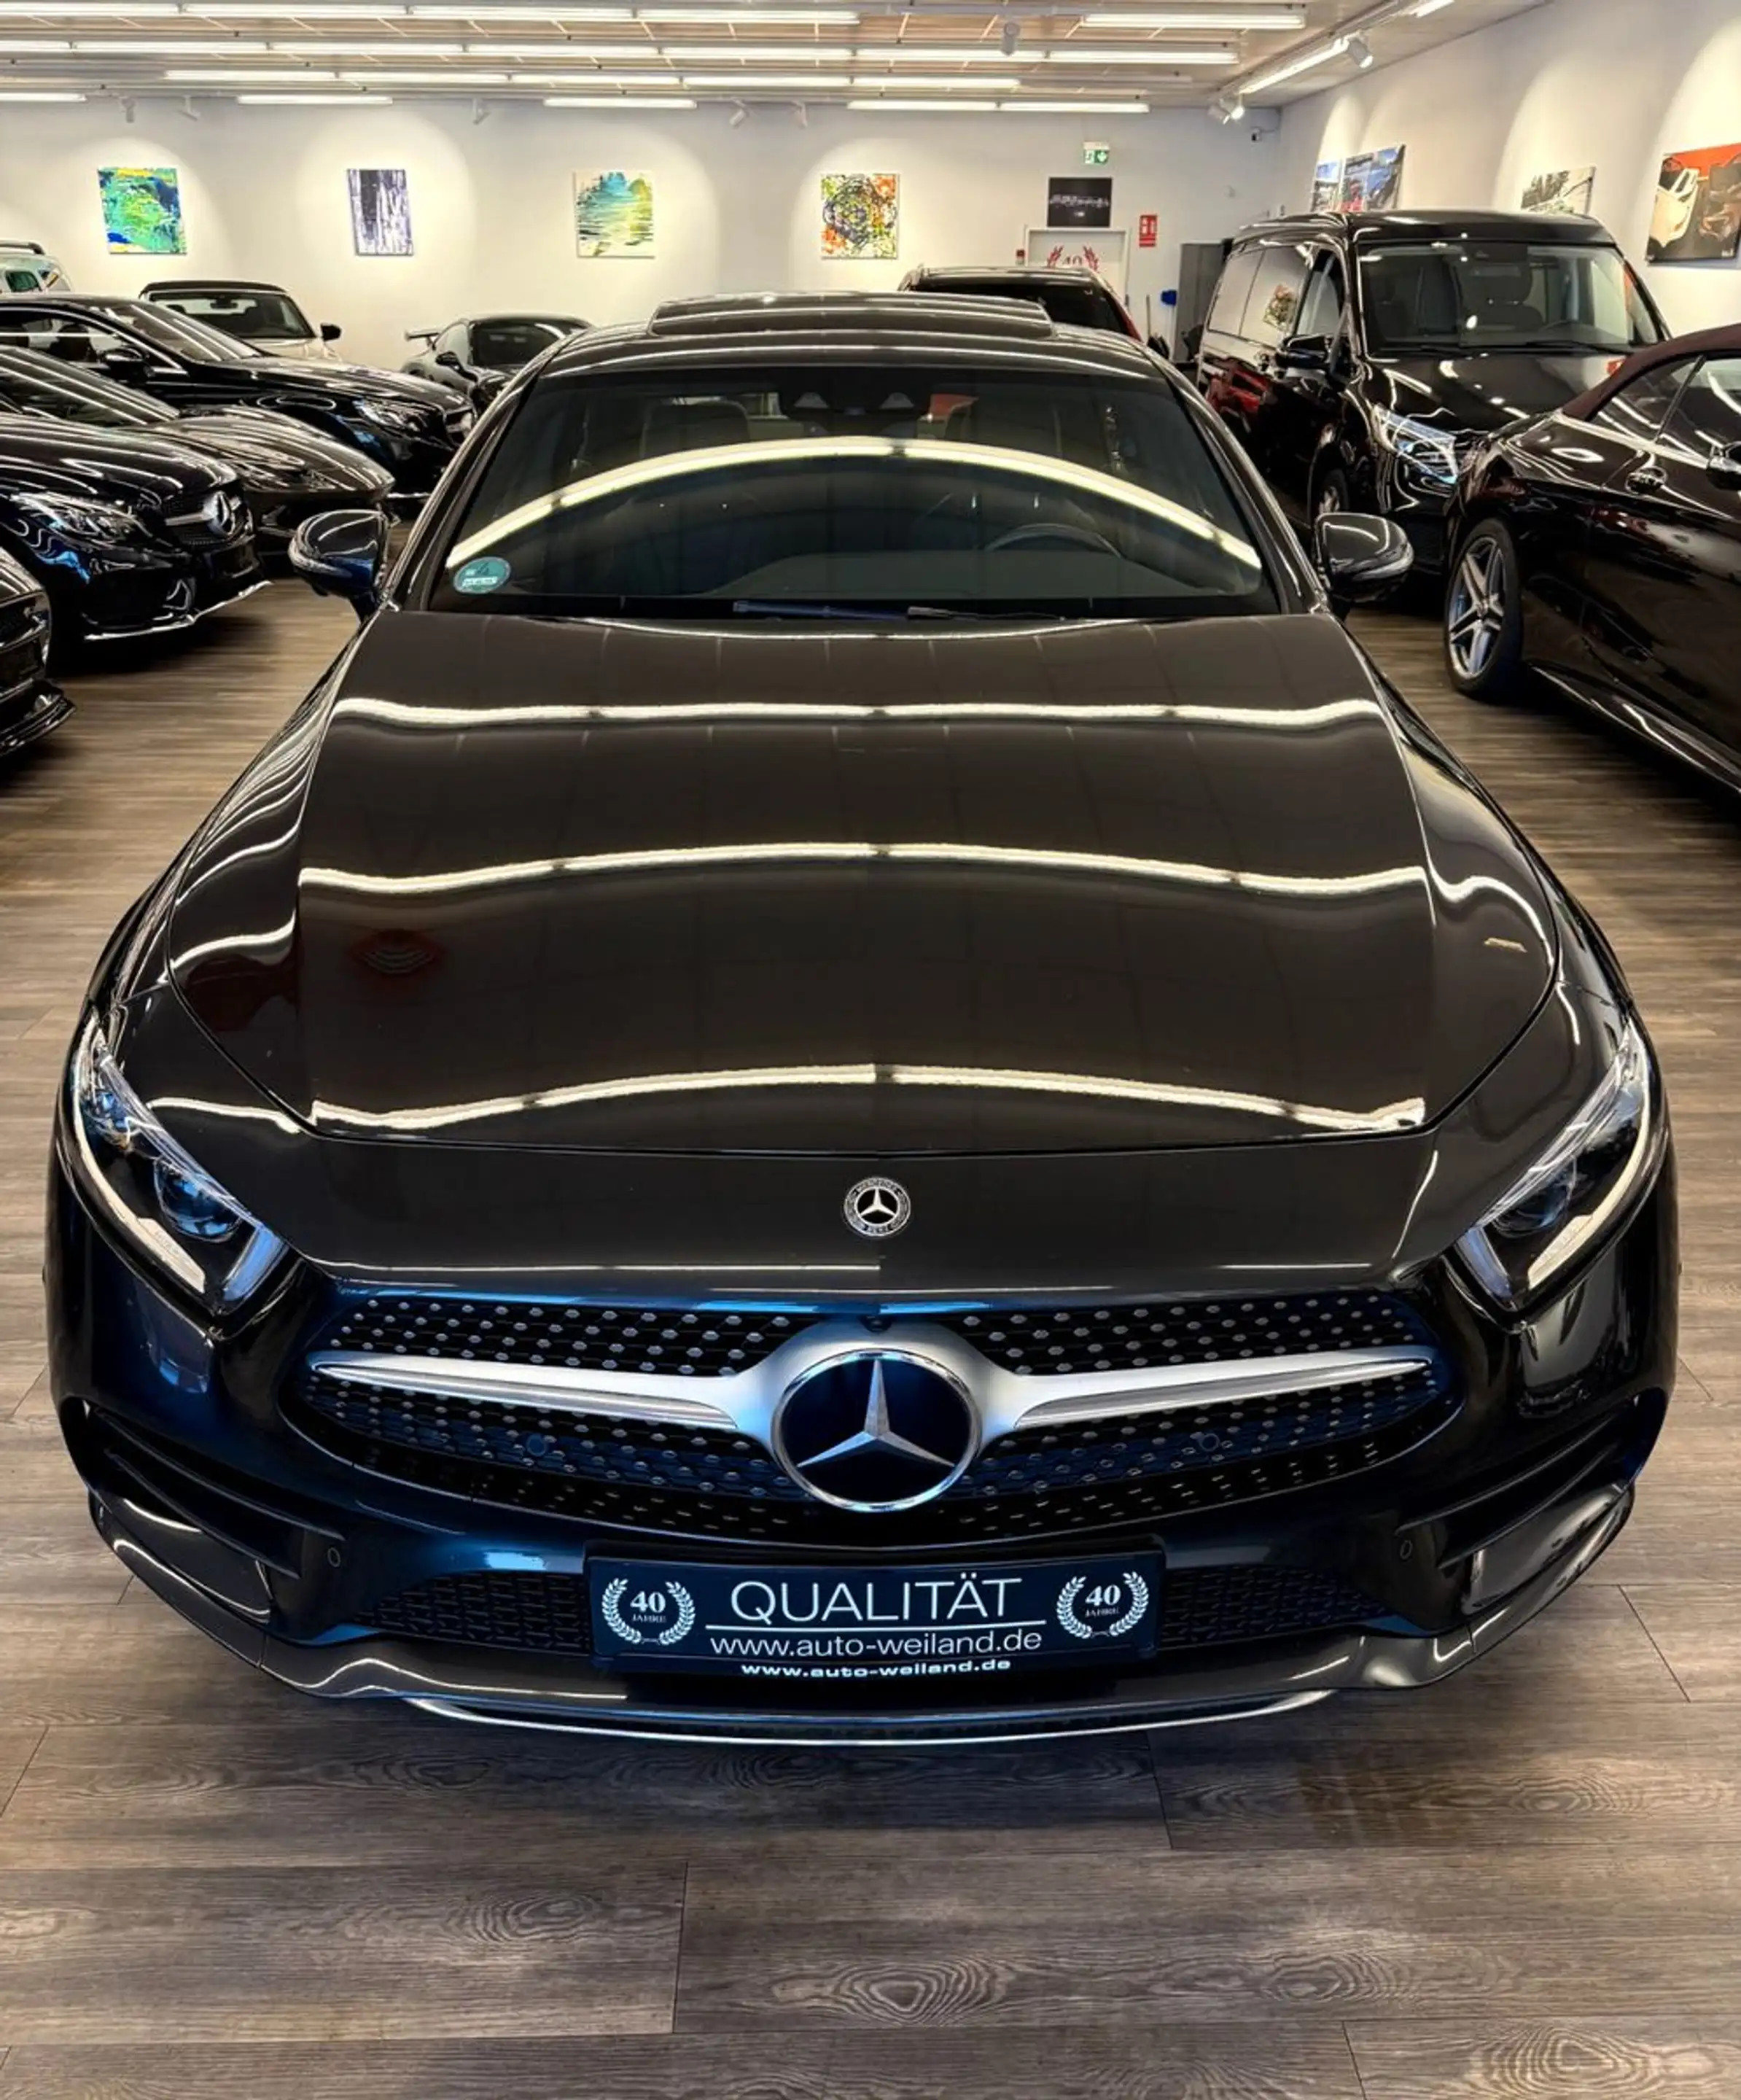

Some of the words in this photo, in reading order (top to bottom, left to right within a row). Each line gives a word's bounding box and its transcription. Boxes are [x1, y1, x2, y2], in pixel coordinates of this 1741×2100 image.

[630, 1590, 666, 1614] 40
[731, 1572, 1022, 1625] QUALITÄT
[1085, 1584, 1121, 1606] 40
[710, 1628, 1043, 1658] www.auto-weiland.de
[741, 1657, 1011, 1679] www.auto-weiland.de
